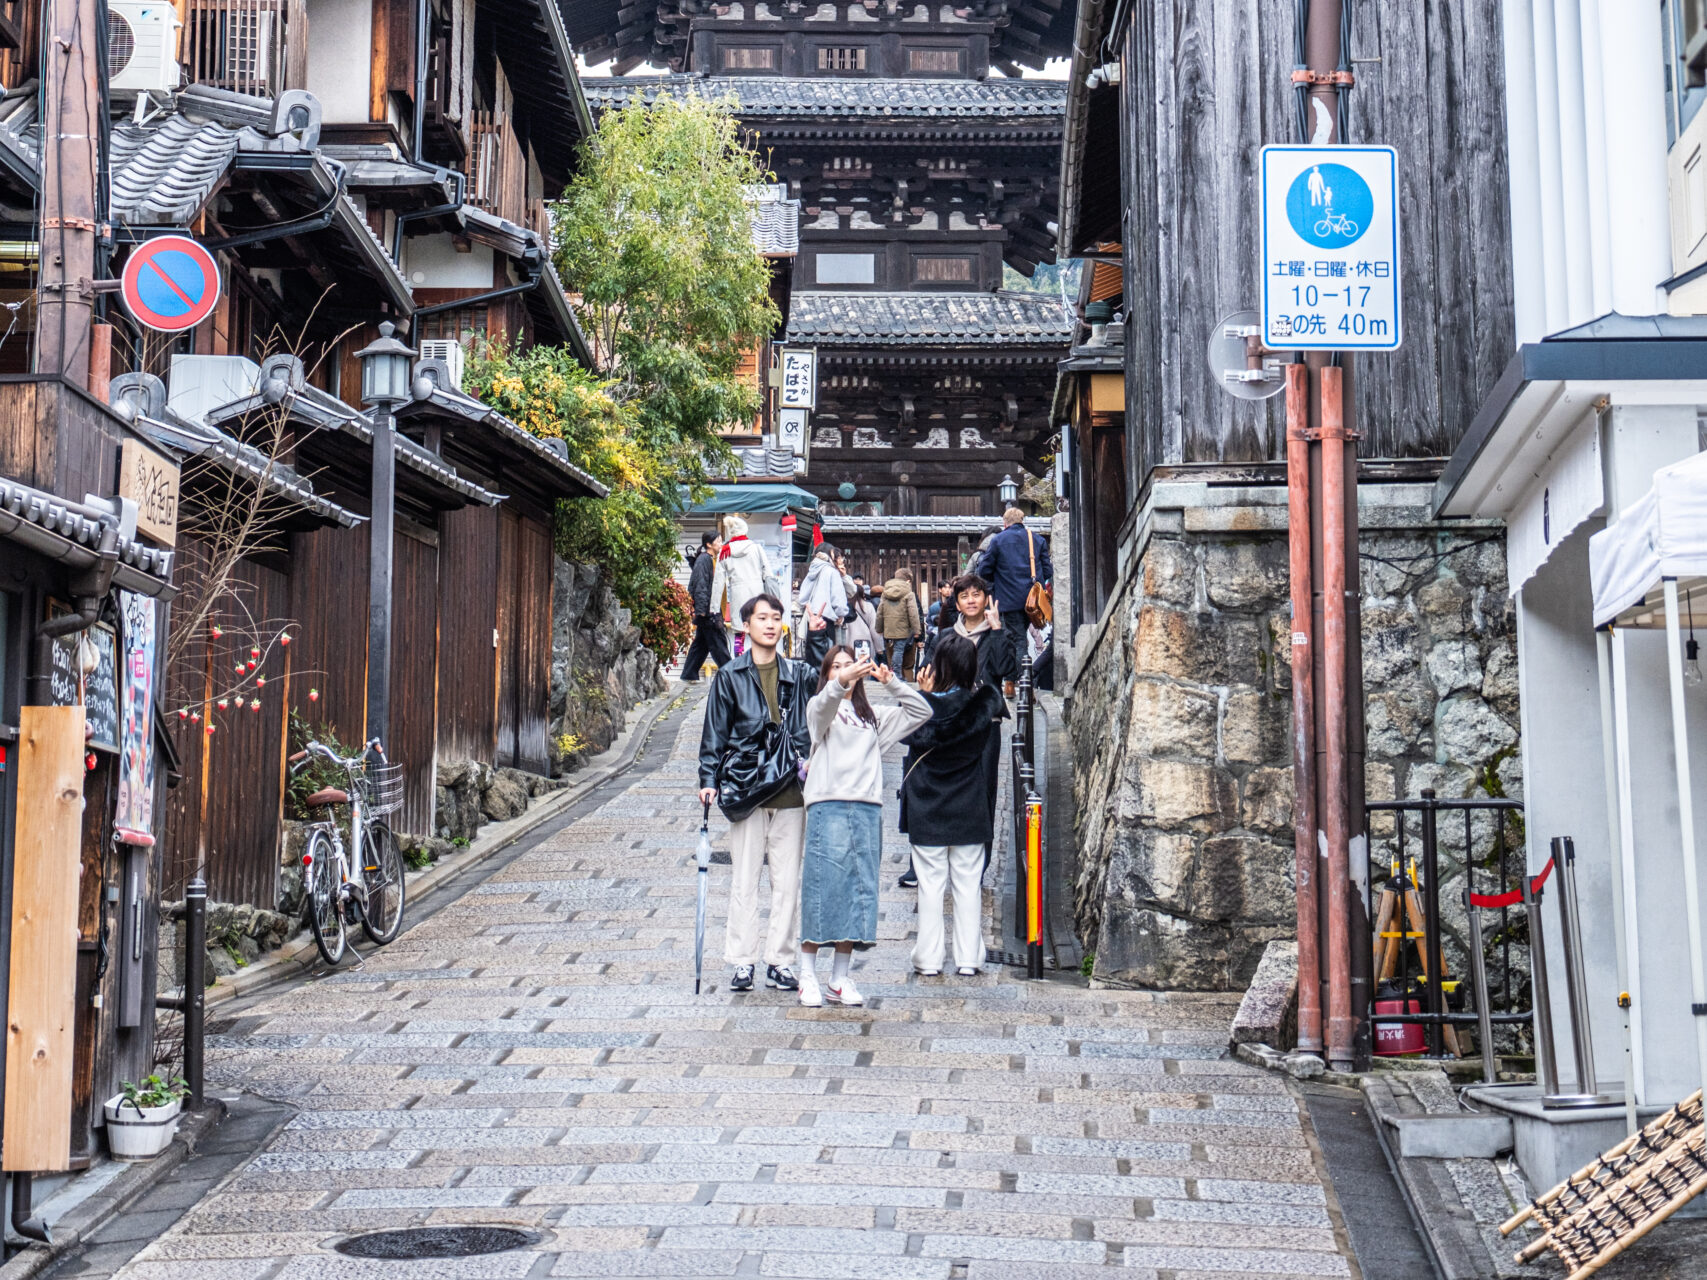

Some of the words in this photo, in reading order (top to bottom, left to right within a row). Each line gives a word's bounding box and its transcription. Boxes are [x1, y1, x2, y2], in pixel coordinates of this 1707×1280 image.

[1271, 260, 1390, 278] 土曜・日曜・休日
[1337, 313, 1388, 336] 40m
[785, 355, 800, 403] たばこ
[800, 362, 810, 396] やさか
[1378, 1029, 1406, 1041] 消火用
